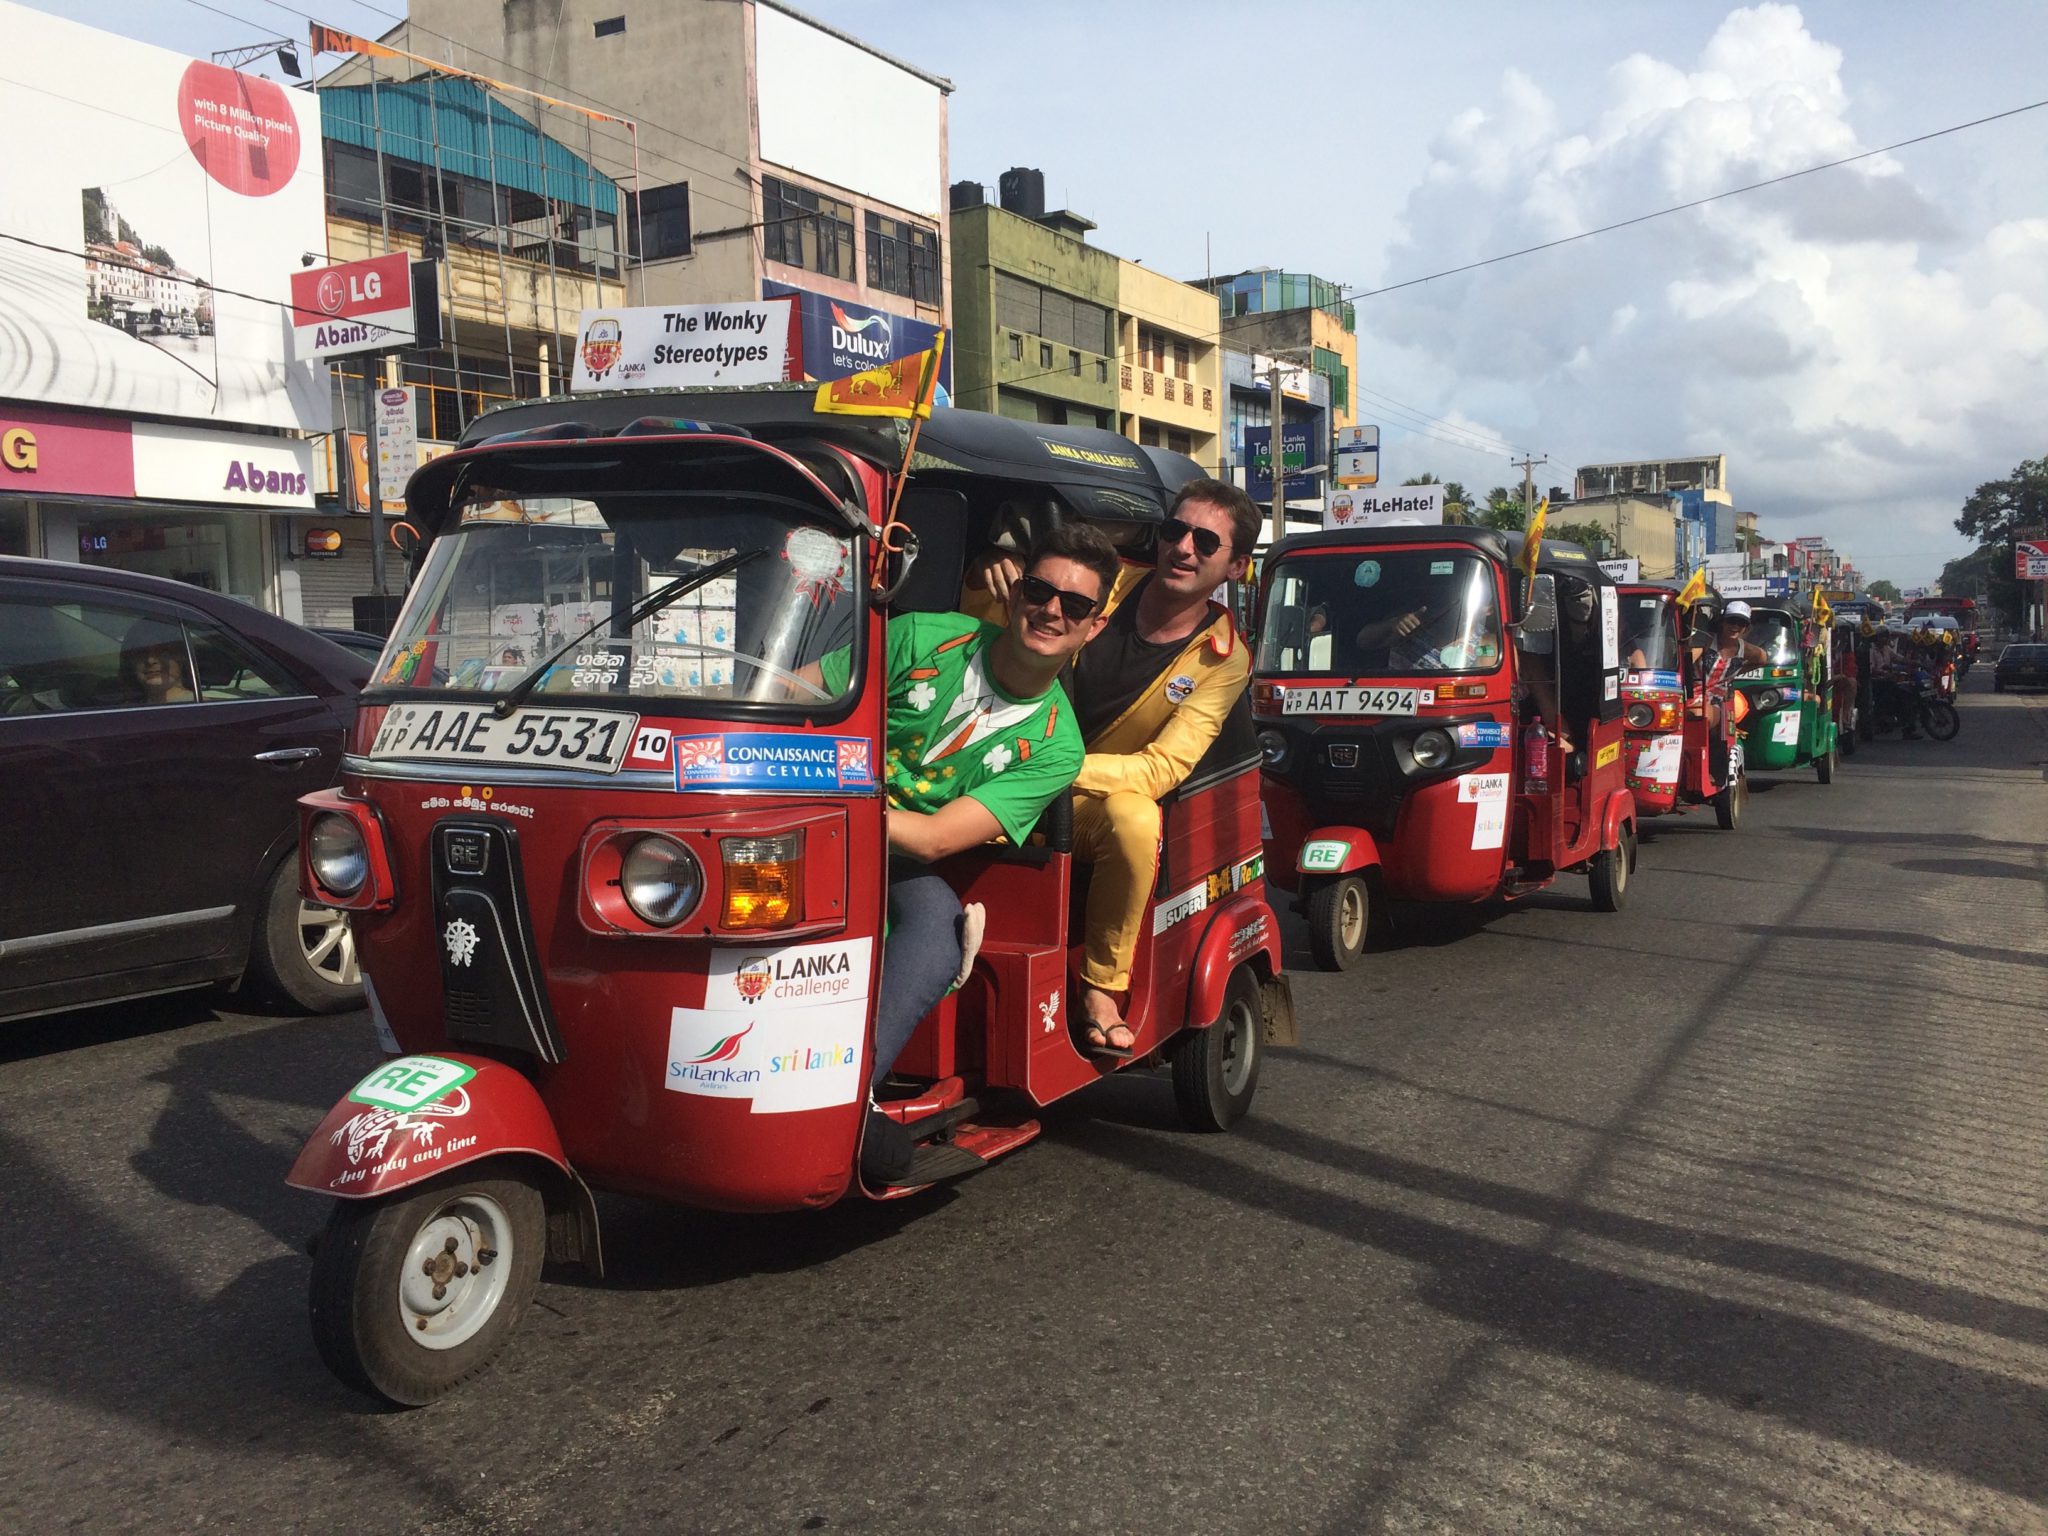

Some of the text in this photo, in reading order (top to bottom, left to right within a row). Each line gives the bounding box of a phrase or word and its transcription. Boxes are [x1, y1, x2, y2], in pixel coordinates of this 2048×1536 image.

[193, 98, 293, 134] with 8 Million pixels
[194, 114, 270, 146] Picture Quality
[350, 271, 382, 303] LG
[663, 309, 768, 335] The Wonky
[315, 324, 368, 350] Abans
[831, 325, 885, 360] Dulux
[653, 343, 768, 368] Stereotypes
[833, 352, 853, 369] let's
[618, 363, 646, 372] LANKA
[0, 426, 38, 472] G
[1253, 439, 1306, 456] Telcom
[1283, 434, 1306, 443] Lanka
[1044, 441, 1139, 469] LANKA CHALLENGE
[222, 460, 307, 496] Abans
[1363, 495, 1434, 514] #LeHate!
[94, 536, 107, 550] LG
[1306, 690, 1349, 711] AAT
[1358, 690, 1413, 712] 9494
[1423, 692, 1431, 702] 5
[410, 710, 494, 753] AAE
[506, 714, 620, 765] 5531
[637, 734, 667, 754] 10
[727, 746, 836, 764] CONNAISSANCE
[728, 765, 837, 779] DE CEYLAN
[1480, 779, 1503, 789] LANKA
[421, 796, 450, 809] සම්මා
[451, 844, 479, 865] RE
[1308, 849, 1338, 863] RE
[1166, 895, 1202, 927] SUPER
[775, 952, 850, 981] LANKA
[774, 976, 850, 998] challenge
[368, 1066, 440, 1097] RE
[669, 1061, 760, 1082] SriLankan
[329, 1135, 477, 1188] Any way any time
